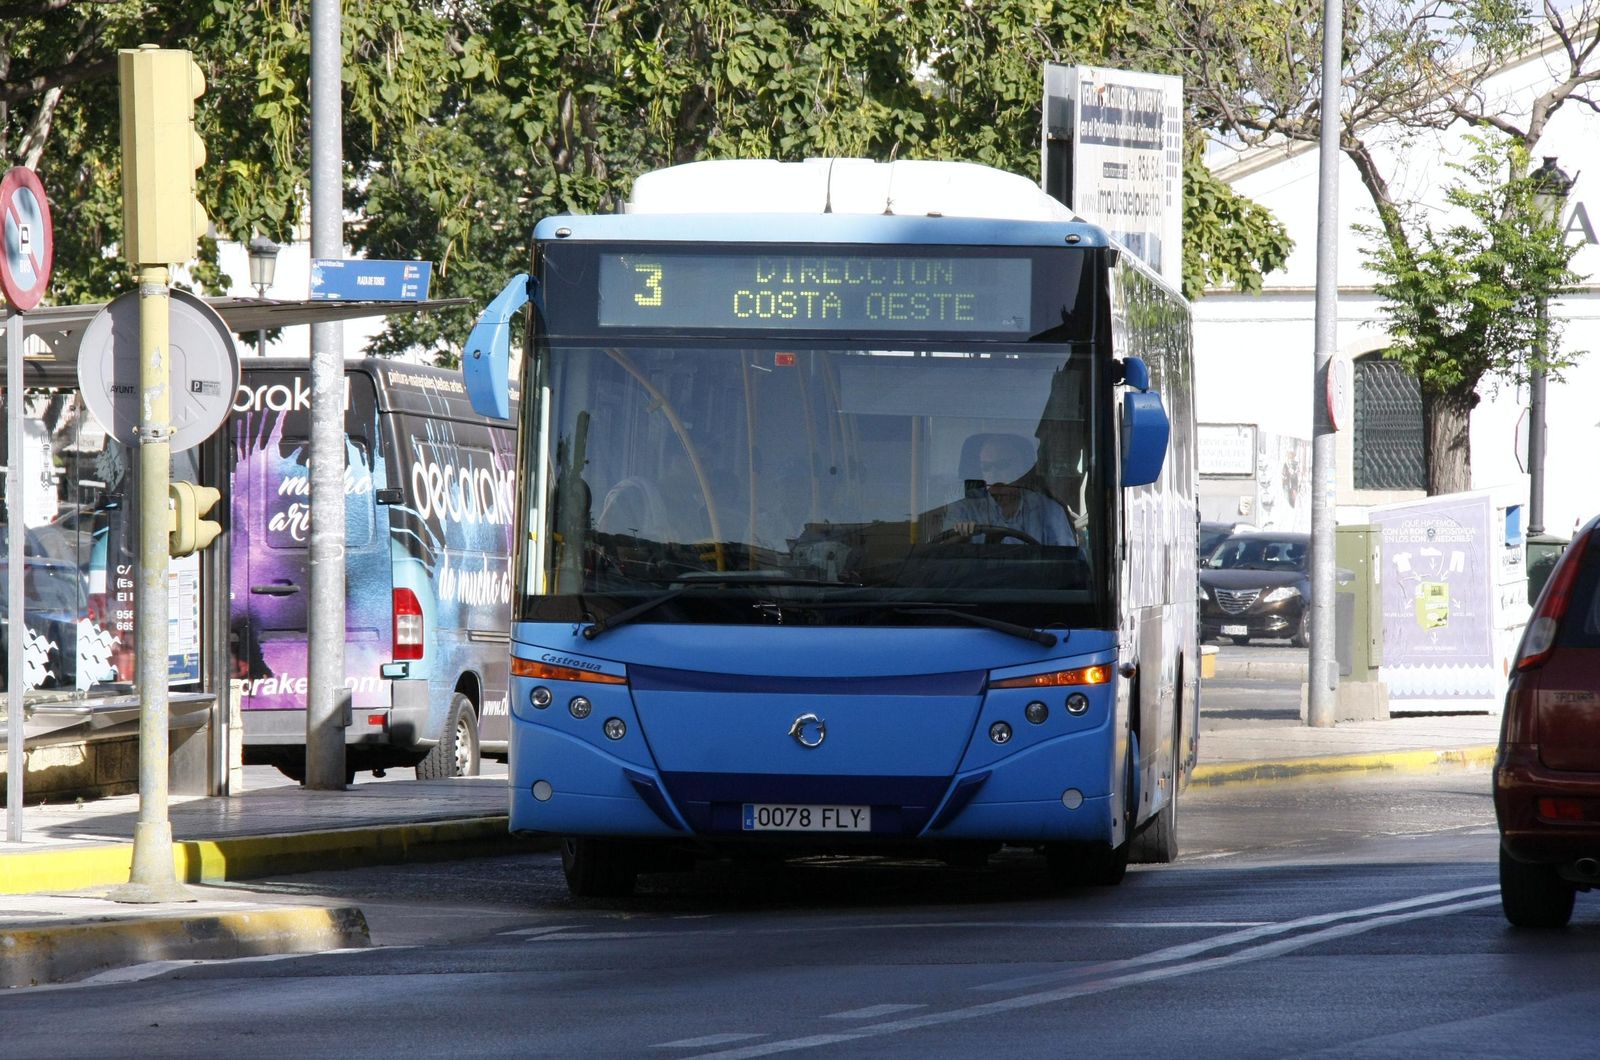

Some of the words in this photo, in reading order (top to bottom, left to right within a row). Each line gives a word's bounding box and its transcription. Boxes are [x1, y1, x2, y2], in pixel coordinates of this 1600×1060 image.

[1562, 202, 1599, 245] A
[634, 263, 662, 306] 3
[756, 259, 954, 284] DIRECCION
[733, 290, 842, 319] COSTA
[866, 292, 976, 321] OESTE
[541, 653, 602, 671] Castrosua
[758, 807, 811, 827] 0078
[822, 808, 862, 828] FLY
